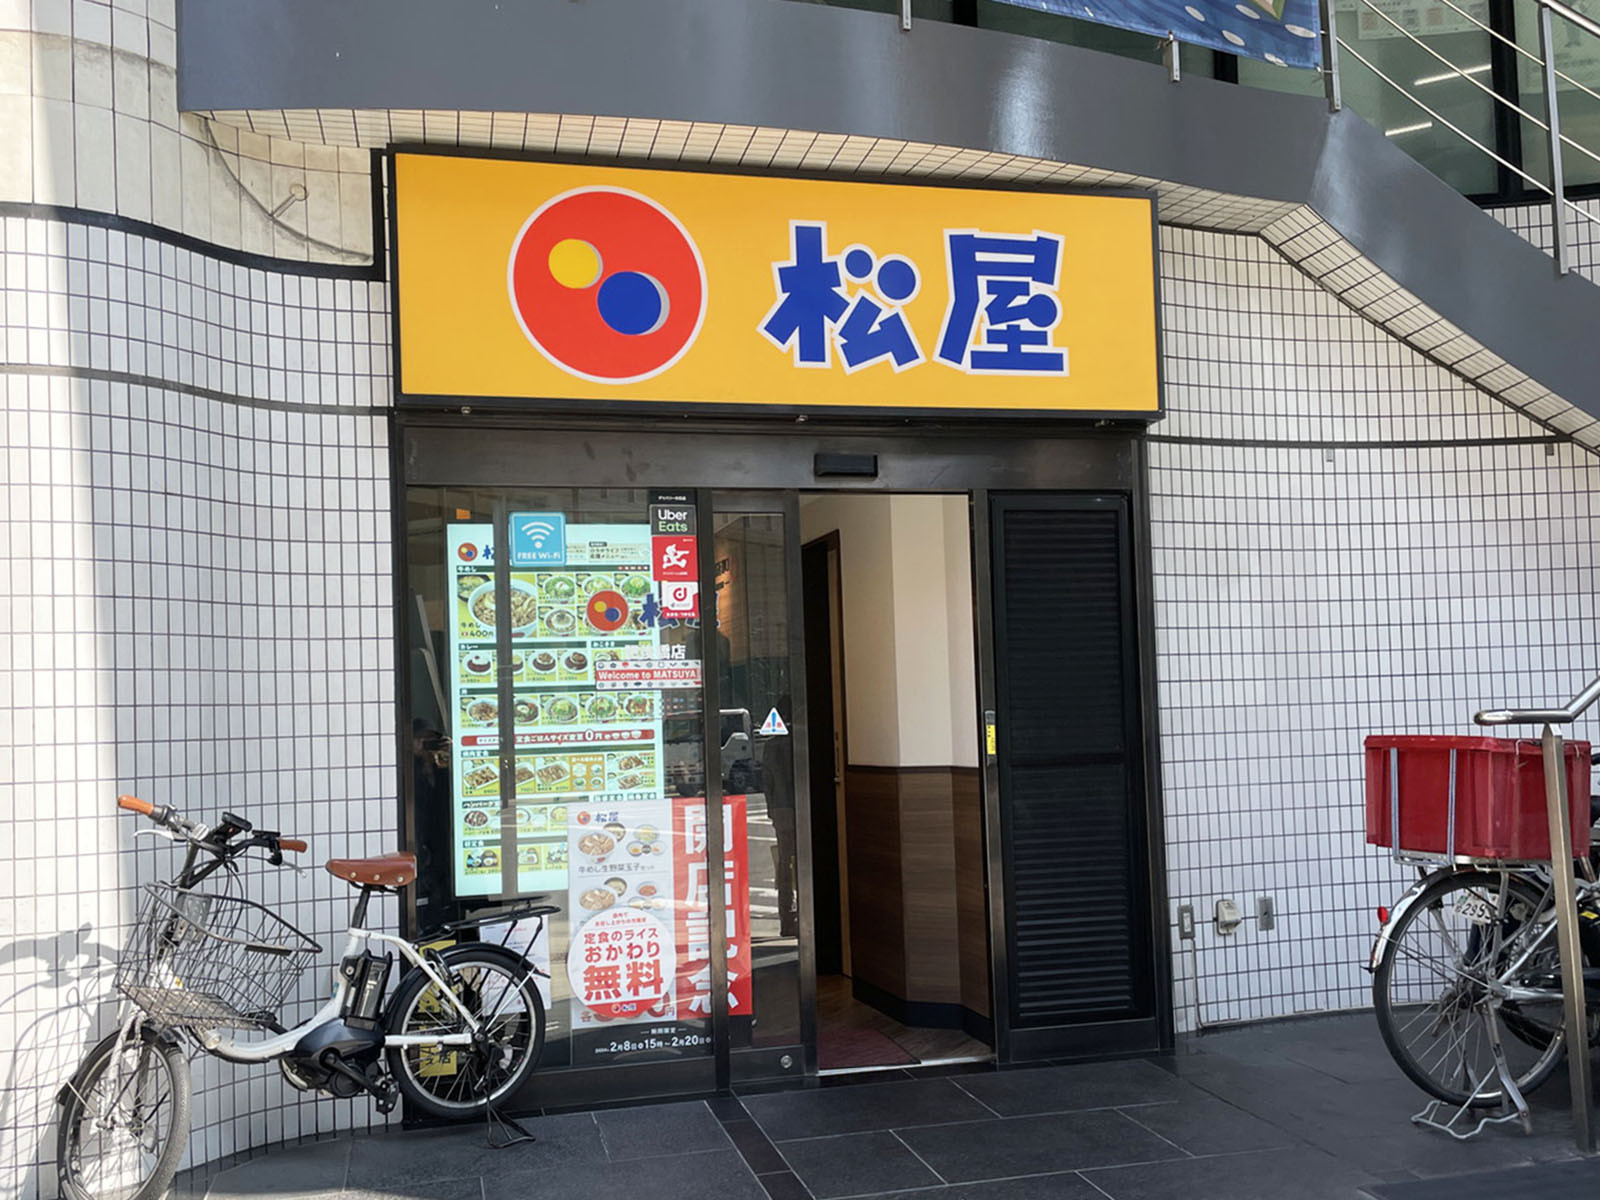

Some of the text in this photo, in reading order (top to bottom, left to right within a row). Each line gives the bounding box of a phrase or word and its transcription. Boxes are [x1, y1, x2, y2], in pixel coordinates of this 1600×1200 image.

[757, 220, 1069, 376] 松屋
[658, 509, 688, 521] Uber
[658, 521, 688, 532] Eats
[518, 551, 537, 560] FREE
[598, 670, 697, 680] Welcome to MATSUYA
[584, 928, 659, 945] 定食のライス
[584, 941, 661, 963] おかわり
[583, 959, 664, 1001] 無料
